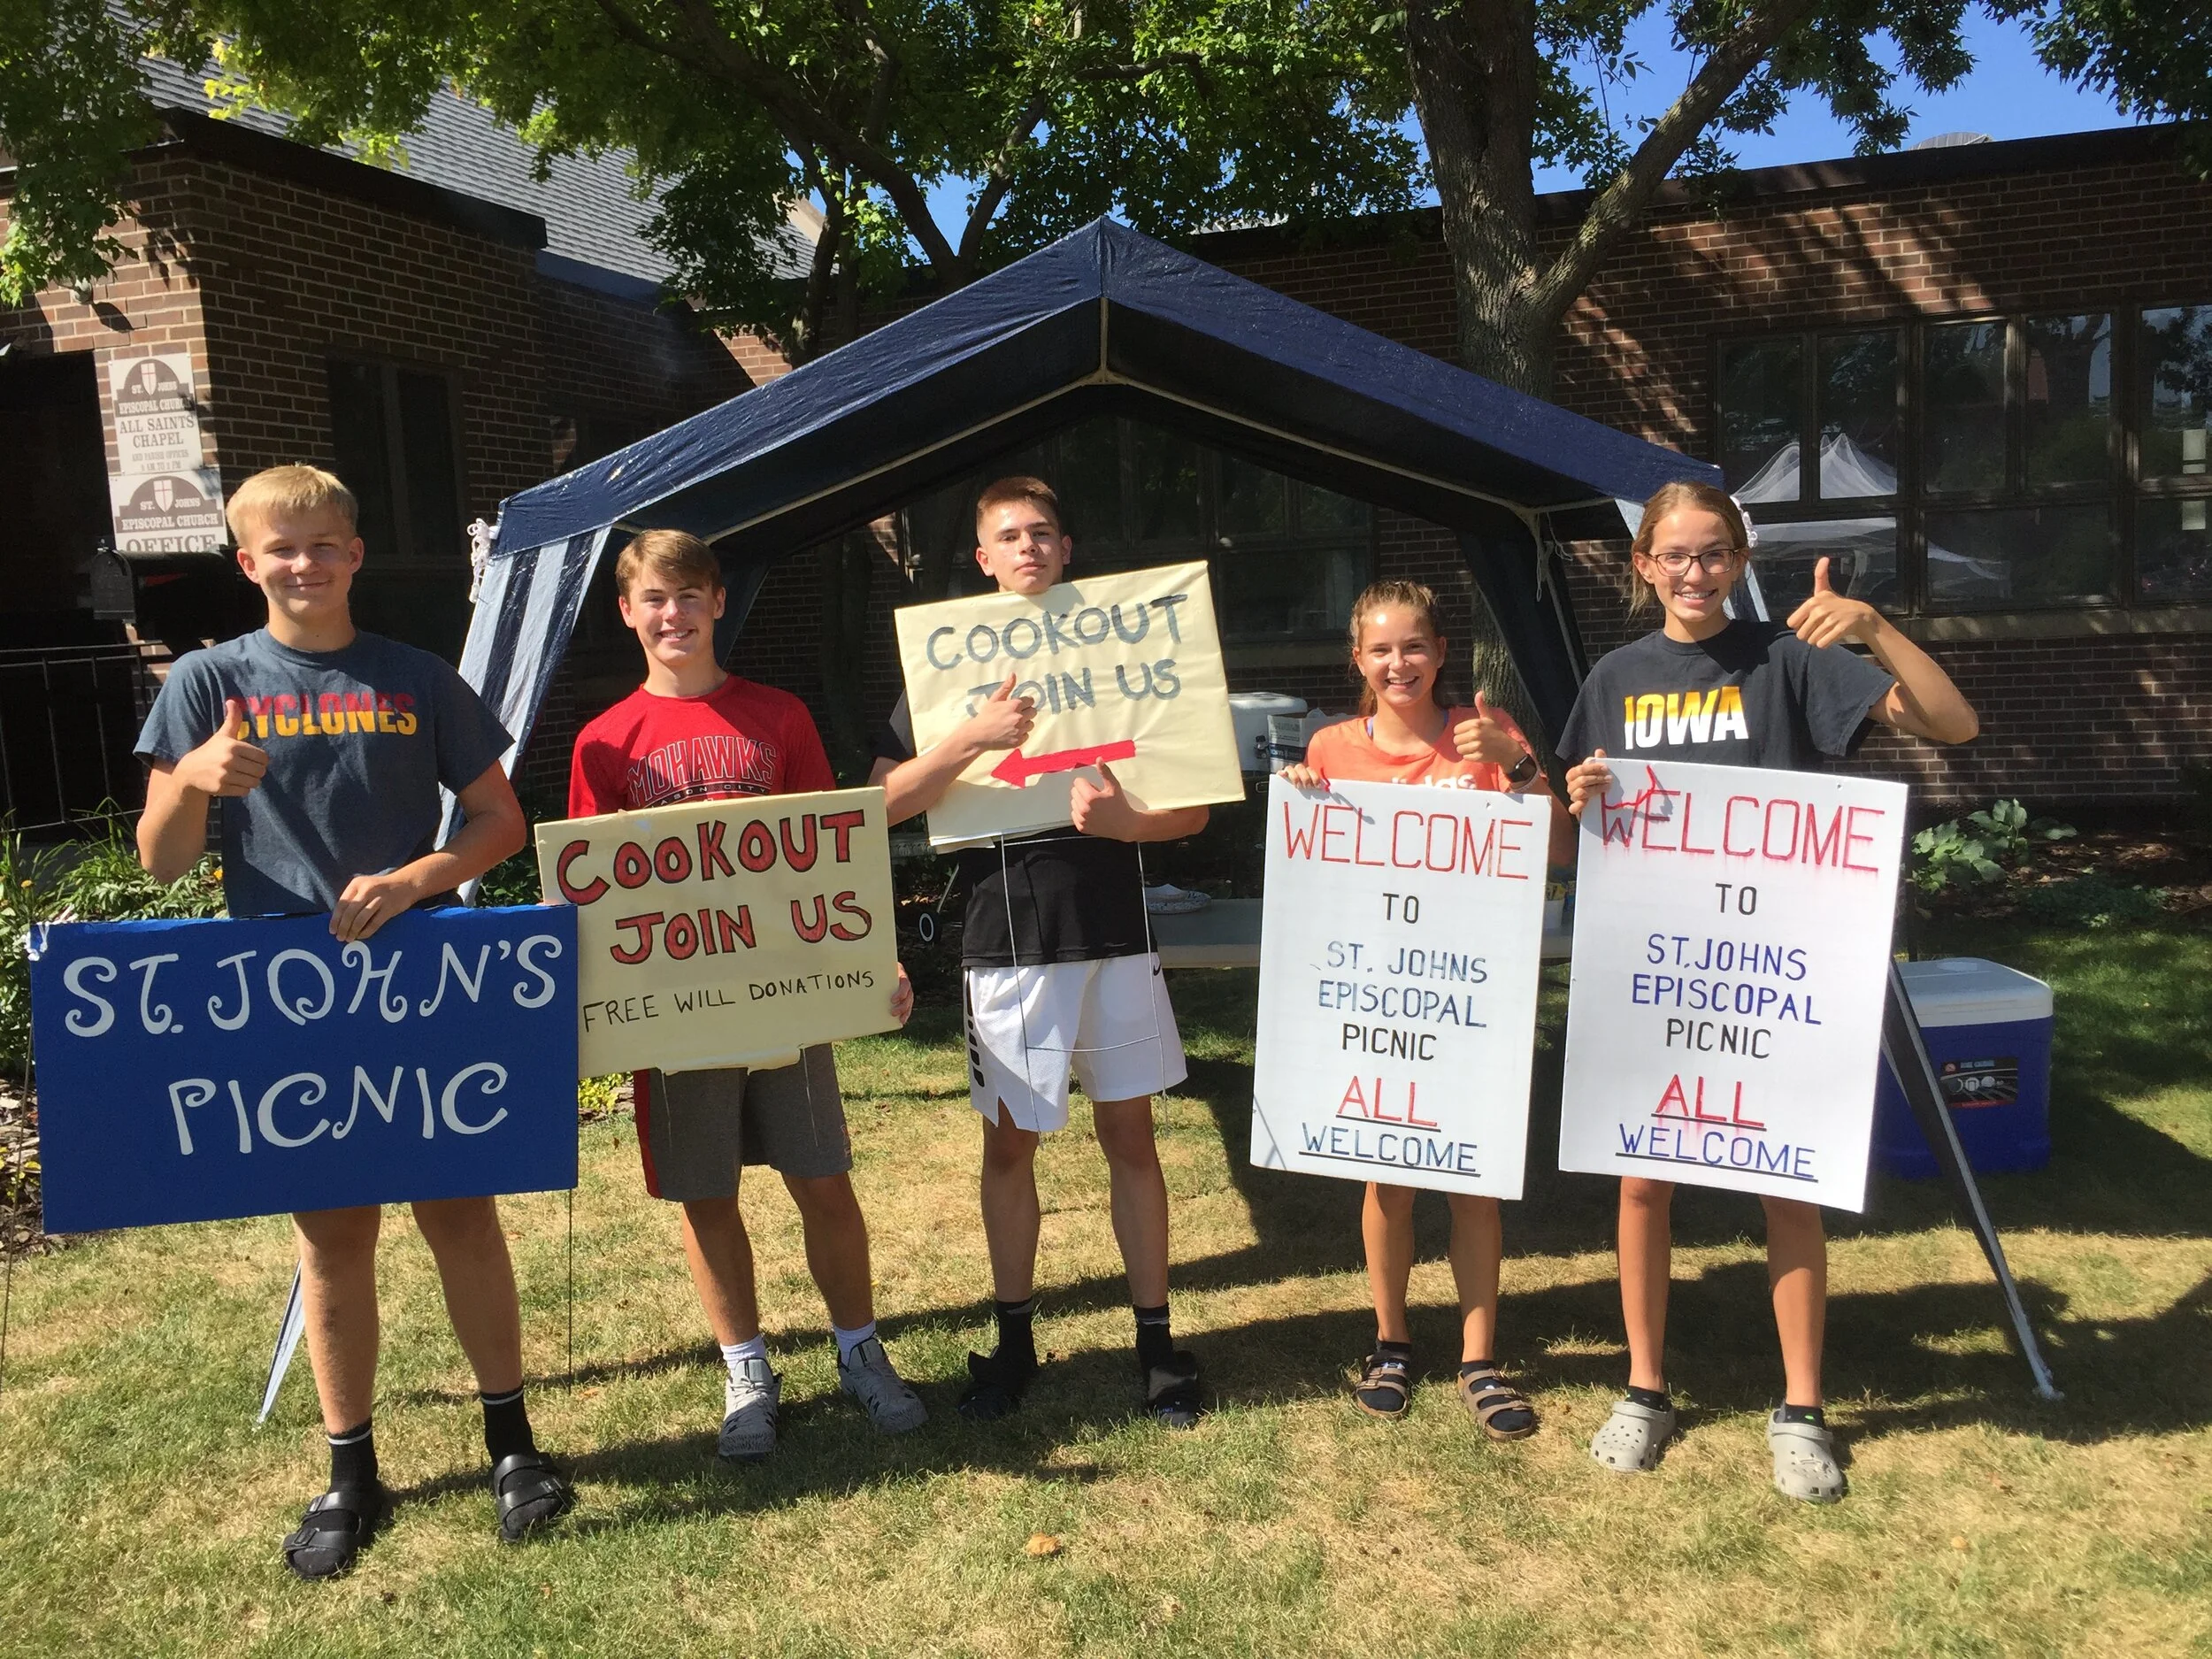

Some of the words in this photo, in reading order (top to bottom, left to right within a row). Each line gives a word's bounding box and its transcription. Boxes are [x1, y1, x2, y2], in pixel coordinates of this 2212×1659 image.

[119, 400, 158, 414] EPISCOPAL
[119, 419, 143, 434] ALL
[147, 414, 195, 432] SAINTS
[133, 432, 184, 449] CHAPEL
[121, 516, 175, 531] EPISCOPAL
[176, 513, 219, 527] CHURCH
[140, 501, 155, 511] ST.
[174, 497, 201, 509] JOHNS
[126, 534, 216, 553] OFFICE
[926, 593, 1188, 671] COOKOUT
[1115, 658, 1182, 701] US
[226, 692, 418, 741] CYCLONES
[1624, 687, 1748, 749] IOWA
[626, 735, 778, 807] MOHAWKS
[723, 783, 765, 793] CITY
[1283, 802, 1533, 880] WELCOME
[1600, 791, 1886, 872] WELCOME
[557, 809, 865, 906] COOKOUT
[1382, 893, 1419, 924] TO
[1715, 883, 1757, 916] TO
[610, 904, 757, 964] JOIN
[790, 890, 872, 943] US
[64, 953, 184, 1038] ST.
[207, 934, 564, 1032] JOHN'S
[1327, 941, 1373, 973] ST.
[1387, 948, 1488, 984] JOHNS
[582, 995, 659, 1033] FREE
[674, 988, 736, 1013] WILL
[749, 970, 875, 1002] DONATIONS
[1318, 980, 1487, 1028] EPISCOPAL
[1632, 974, 1822, 1025] EPISCOPAL
[1341, 1024, 1437, 1062] PICNIC
[1666, 1018, 1771, 1059] PICNIC
[168, 1062, 508, 1156] PICNIC
[1337, 1075, 1438, 1127] ALL
[1655, 1074, 1765, 1127] ALL
[1302, 1122, 1478, 1173] WELCOME
[1618, 1124, 1817, 1180] WELCOME
